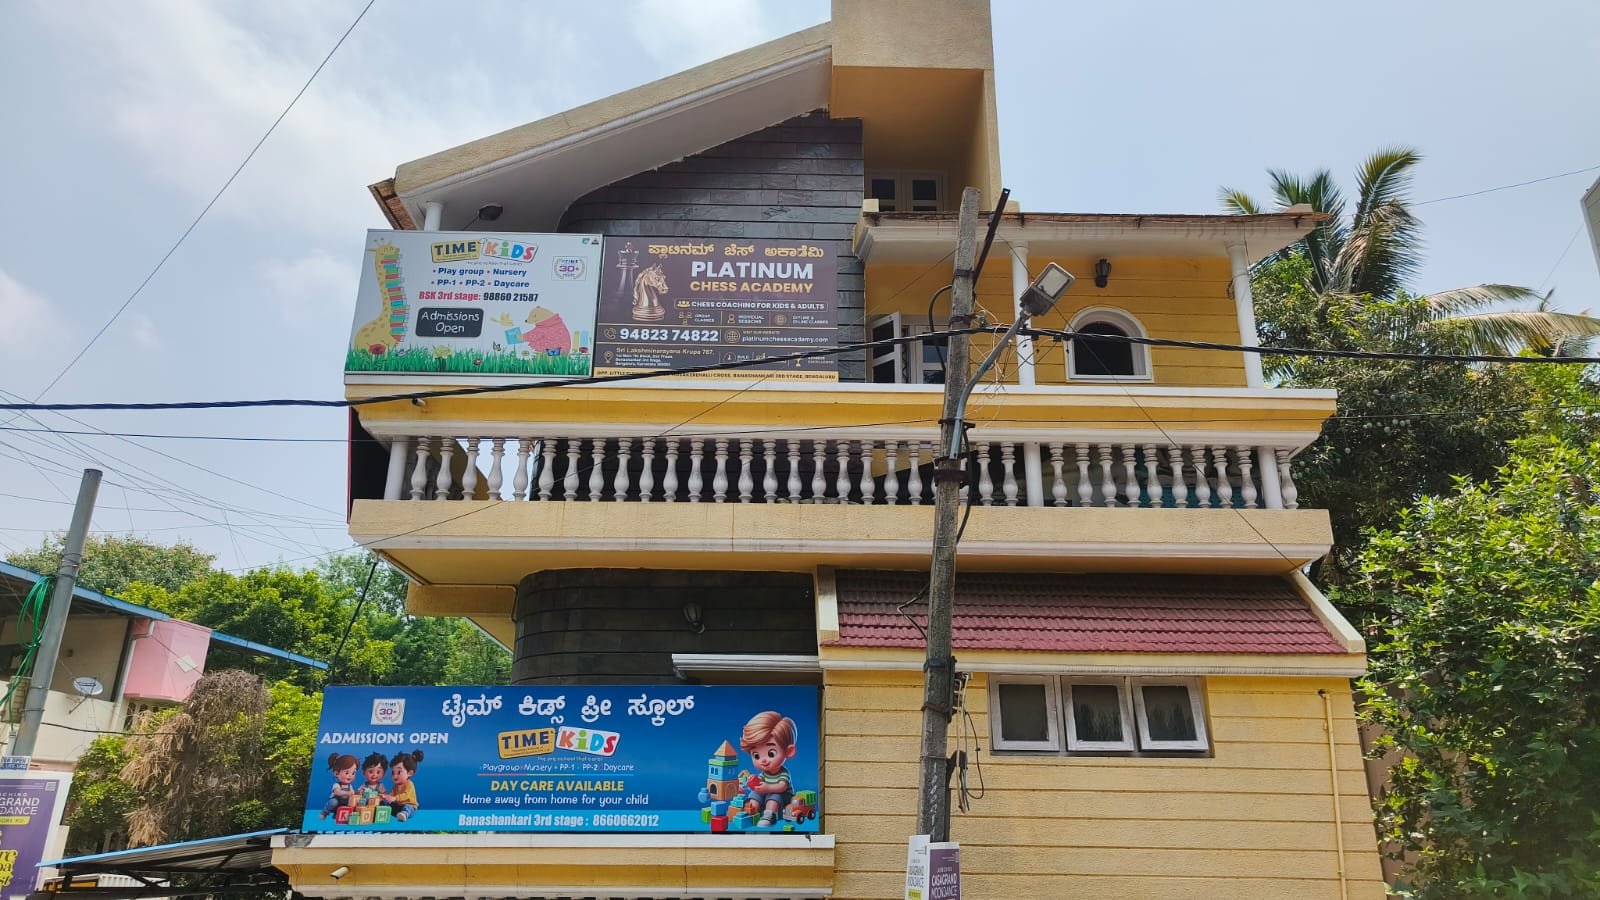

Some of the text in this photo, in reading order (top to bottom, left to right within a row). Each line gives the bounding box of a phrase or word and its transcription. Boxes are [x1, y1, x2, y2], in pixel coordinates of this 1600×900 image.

[434, 242, 476, 256] TIME
[492, 268, 527, 277] Nursery
[691, 261, 814, 280] PLATINUM
[494, 280, 530, 288] Daycare
[690, 281, 814, 293] CHESS ACADEMY
[419, 291, 539, 302] BSK 3rd stage: 98860 21587
[421, 310, 480, 321] Admissions
[435, 322, 465, 334] Open
[620, 328, 719, 341] 94823 74822
[441, 693, 695, 728] ಟೈಮ್ ಕಿಡ್ಸ್ ಪ್ರೀ ಸ್ಕೂಲ್
[320, 732, 449, 744] ADMISSIONS OPEN
[502, 730, 550, 750] TIME
[482, 764, 520, 772] Playgroup
[524, 763, 553, 772] Nursery
[603, 764, 634, 772] Daycare
[490, 780, 624, 791] DAY CARE AVAILABLE
[462, 794, 649, 807] Home away from home for your child
[458, 814, 532, 826] Banashankari
[534, 814, 552, 826] 3rd
[554, 815, 584, 827] stage
[593, 814, 659, 826] 8660662012
